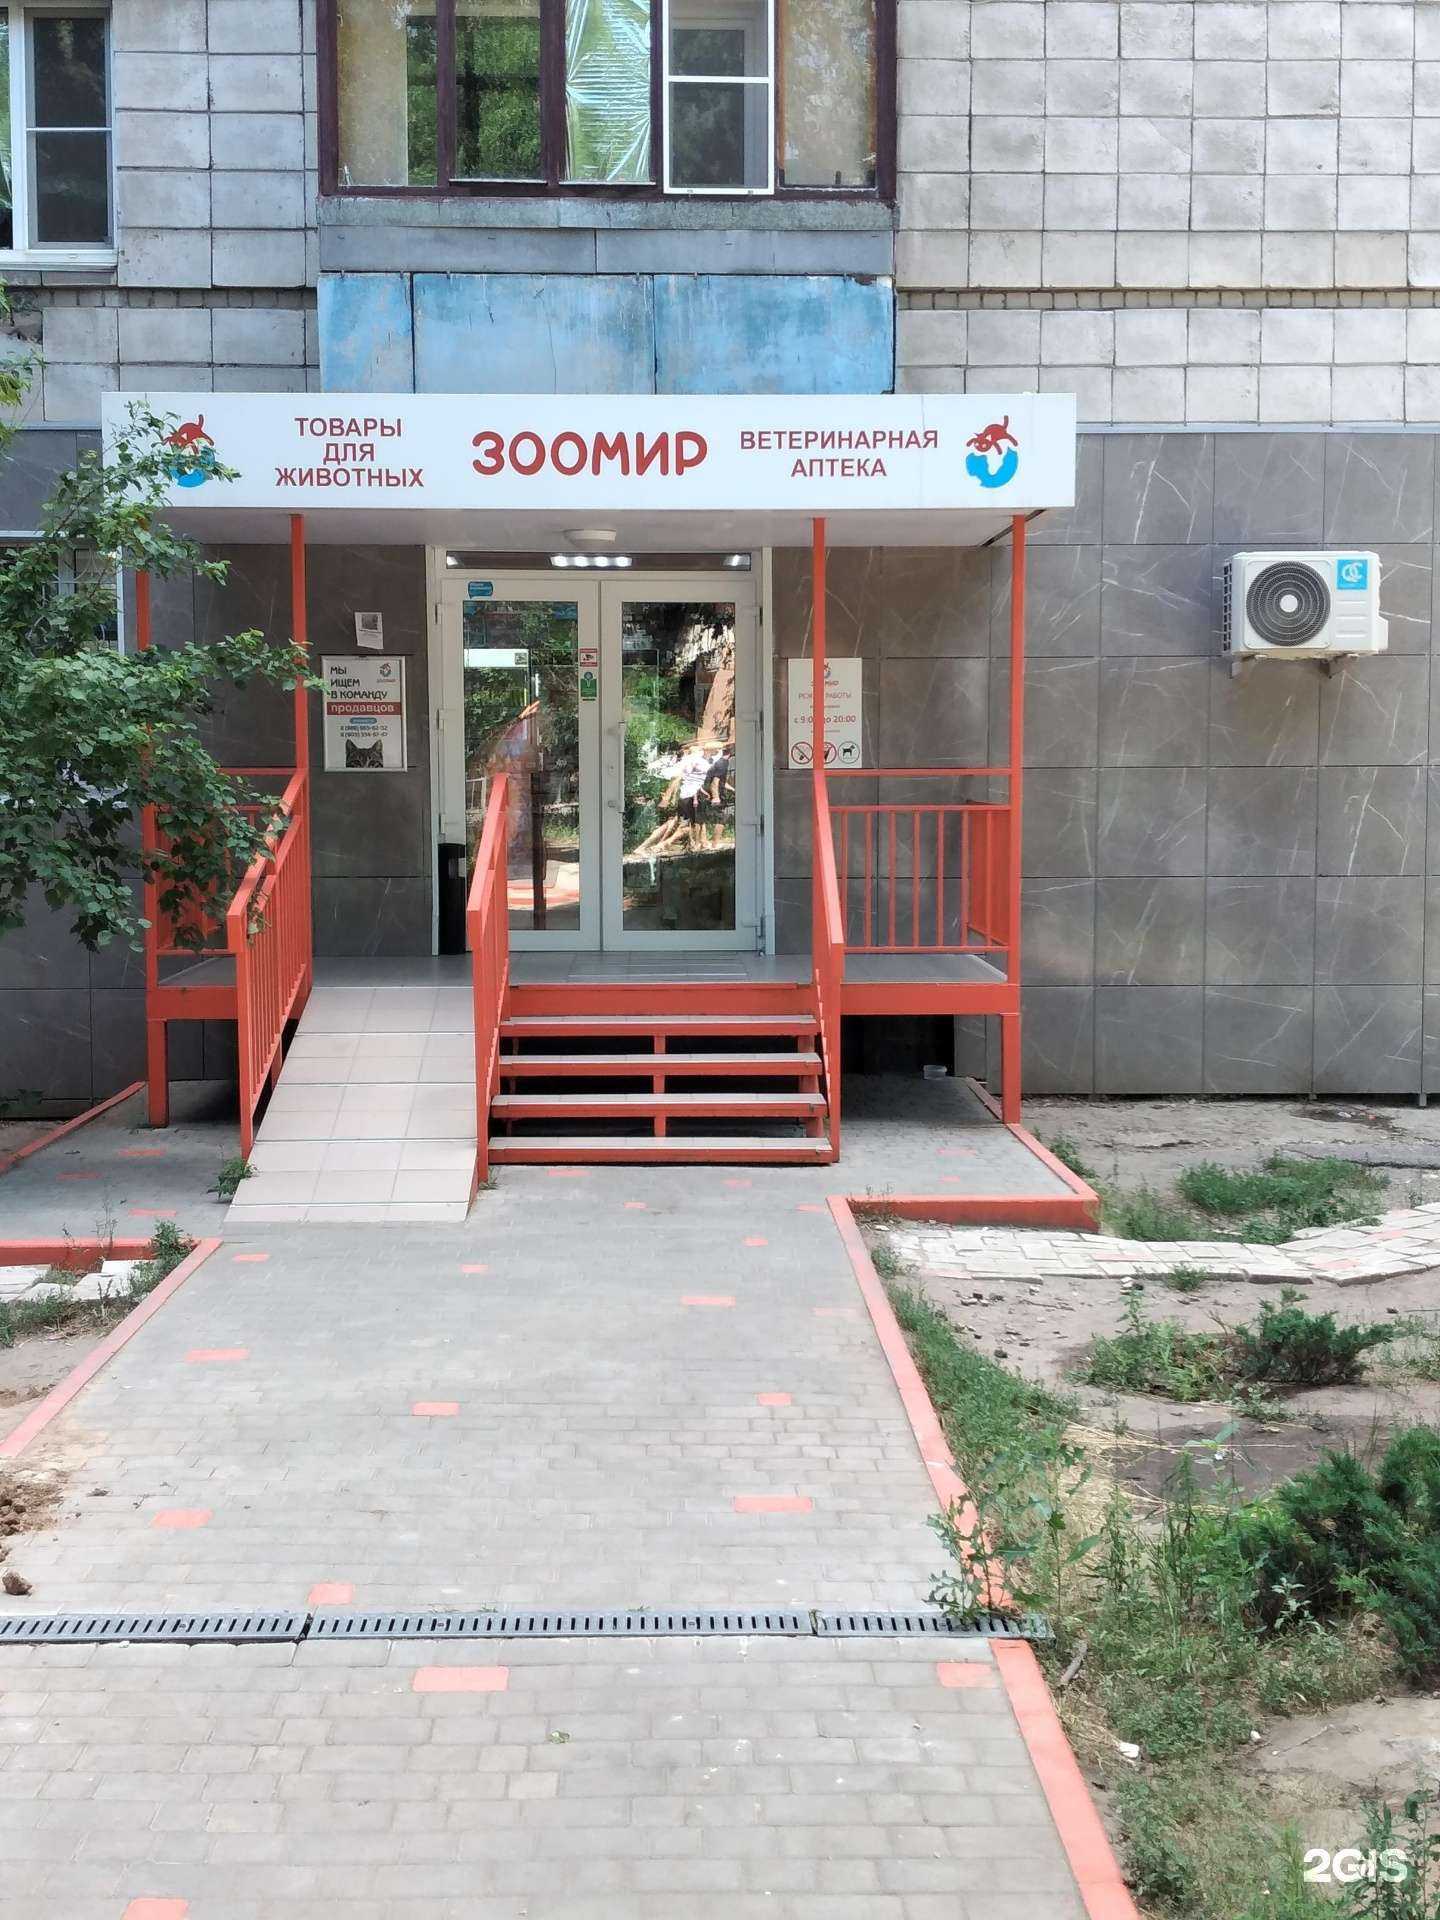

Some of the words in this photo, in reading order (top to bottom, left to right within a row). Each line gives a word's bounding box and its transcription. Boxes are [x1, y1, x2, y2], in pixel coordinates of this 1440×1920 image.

[294, 417, 402, 437] ТОВАРЫ
[740, 429, 938, 450] ВЕТЕРИНАРНАЯ
[322, 442, 375, 463] ДЛЯ
[472, 430, 708, 476] ЗООМИР
[275, 467, 424, 488] ЖИВОТНЫХ
[790, 458, 887, 478] АПТЕКА
[330, 665, 347, 675] МЫ
[330, 678, 361, 689] ИЩЕМ
[330, 690, 338, 699] В
[340, 690, 388, 701] КОМАНДУ
[331, 704, 395, 714] продавцов
